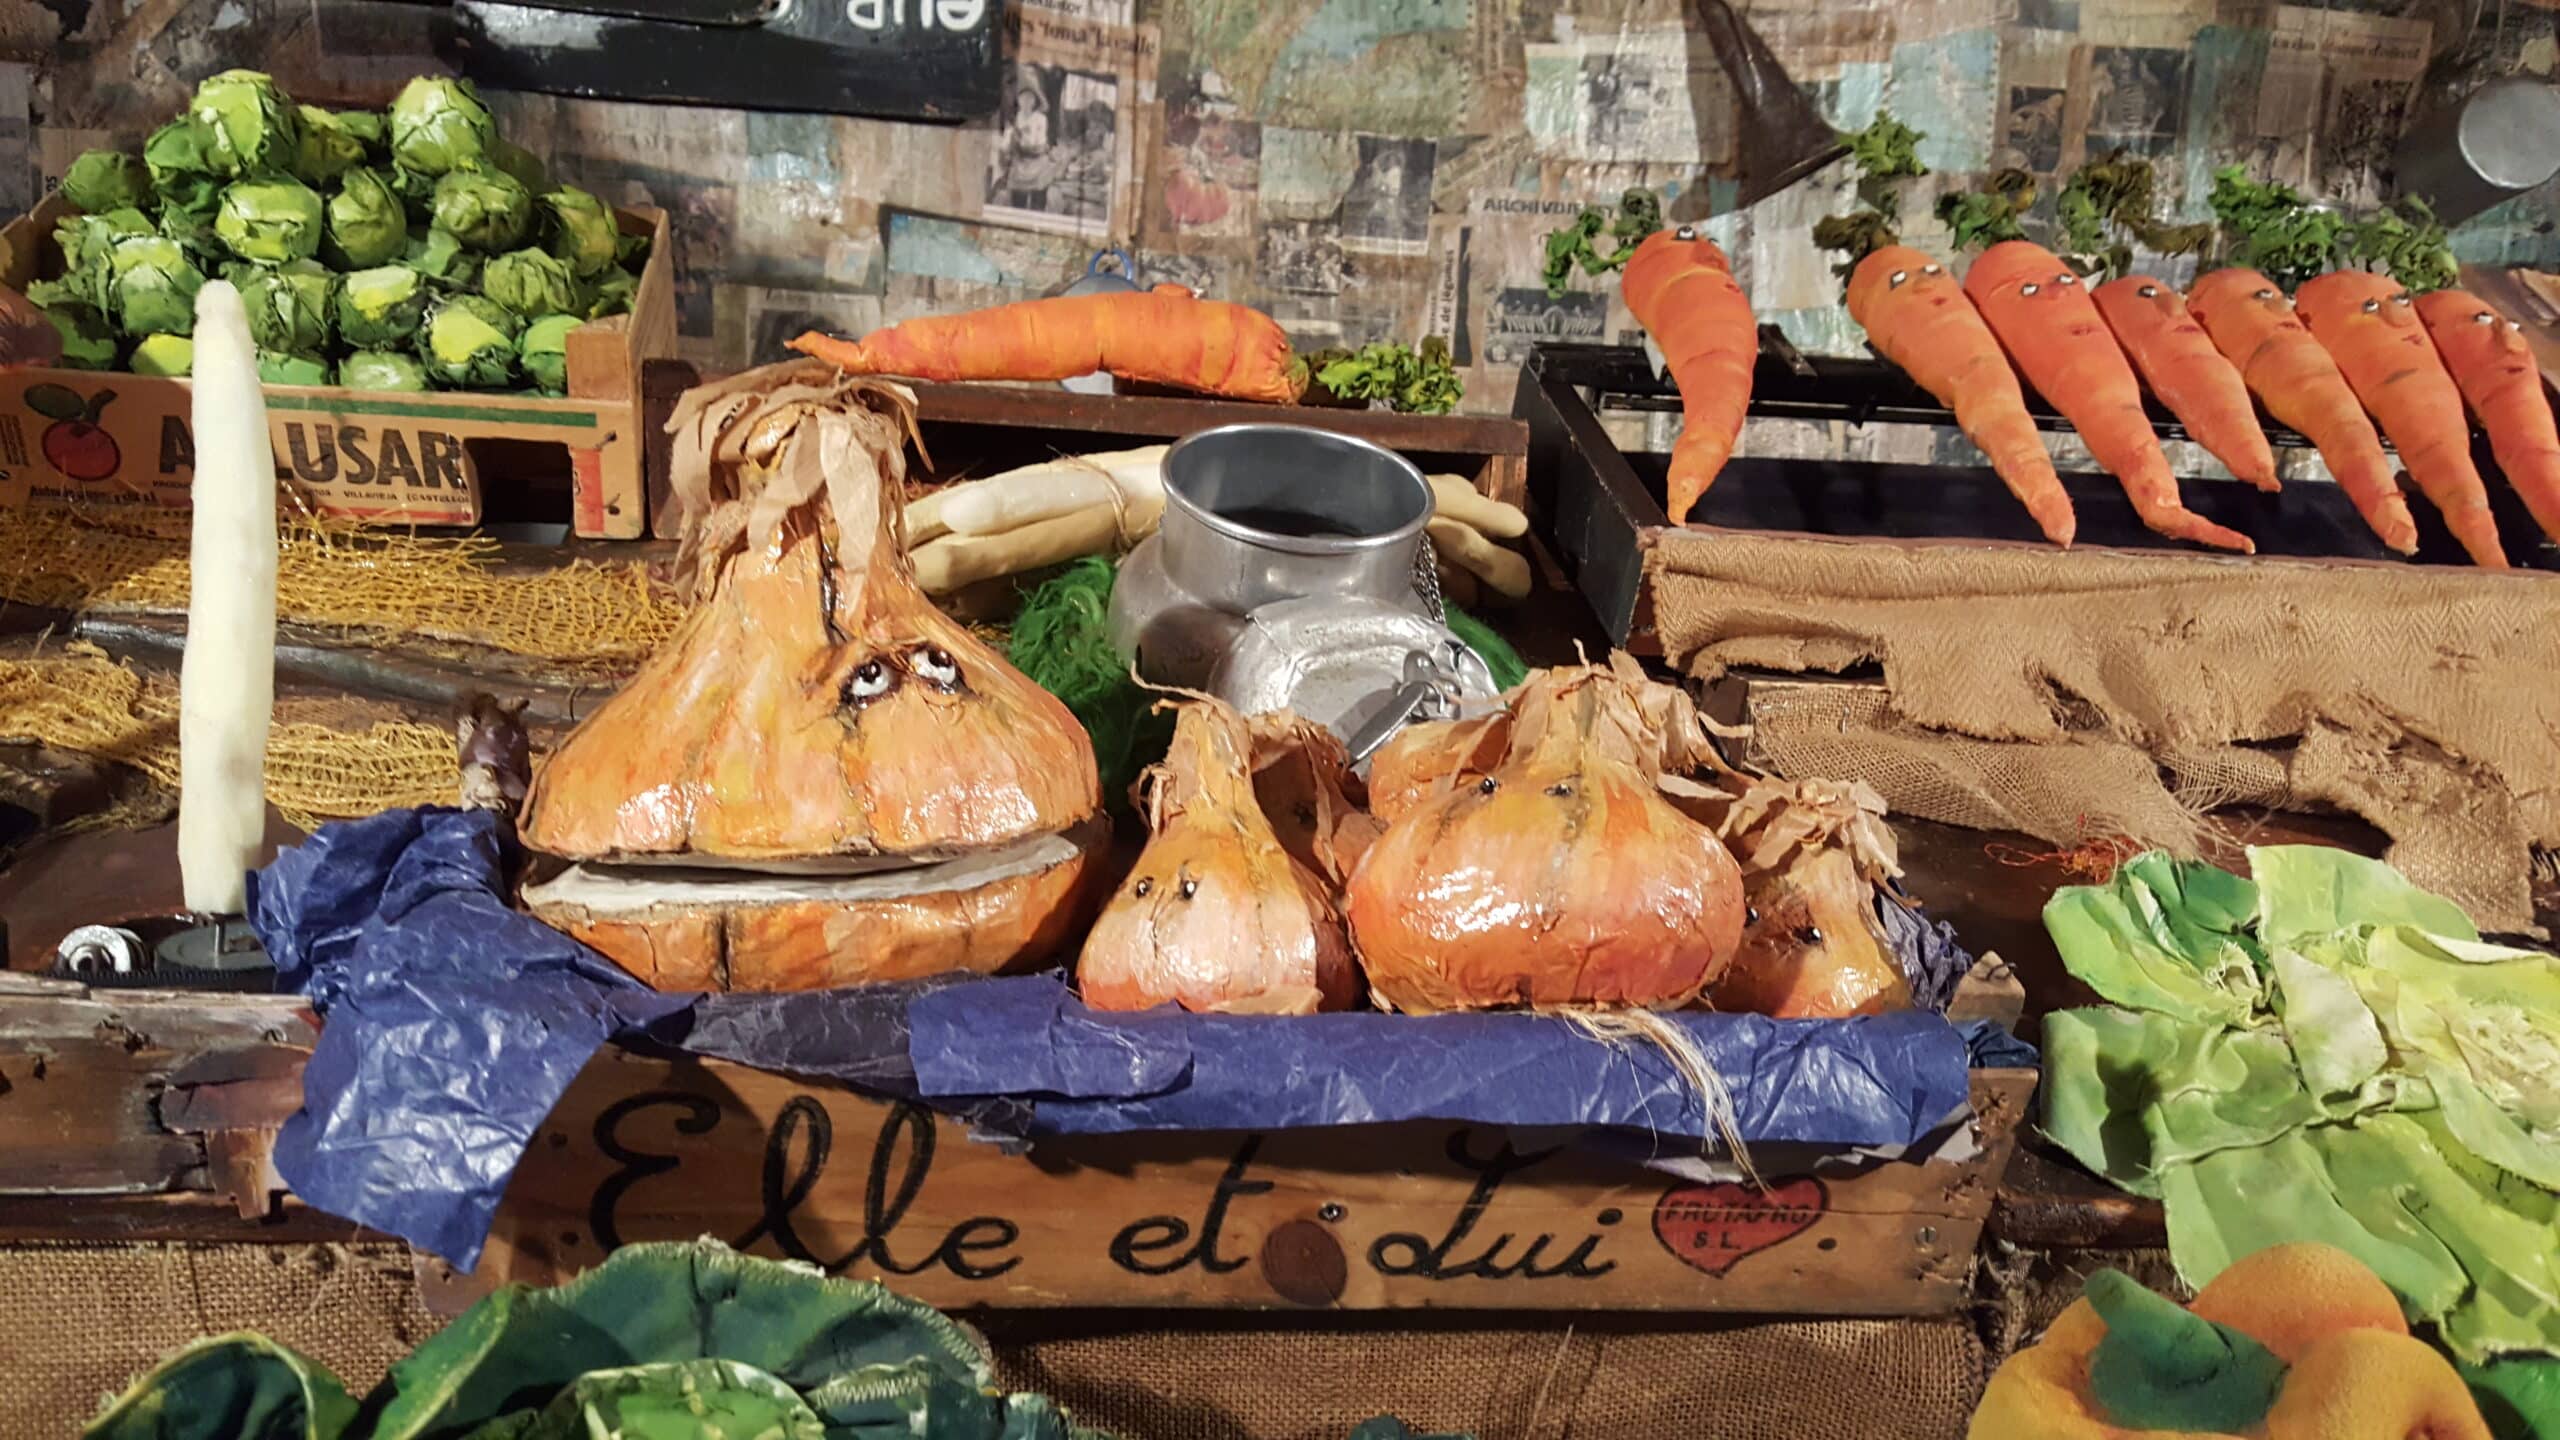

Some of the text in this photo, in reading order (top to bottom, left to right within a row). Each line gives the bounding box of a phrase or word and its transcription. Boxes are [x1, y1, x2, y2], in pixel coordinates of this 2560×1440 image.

[590, 1091, 1624, 1280] Elle et Lui
